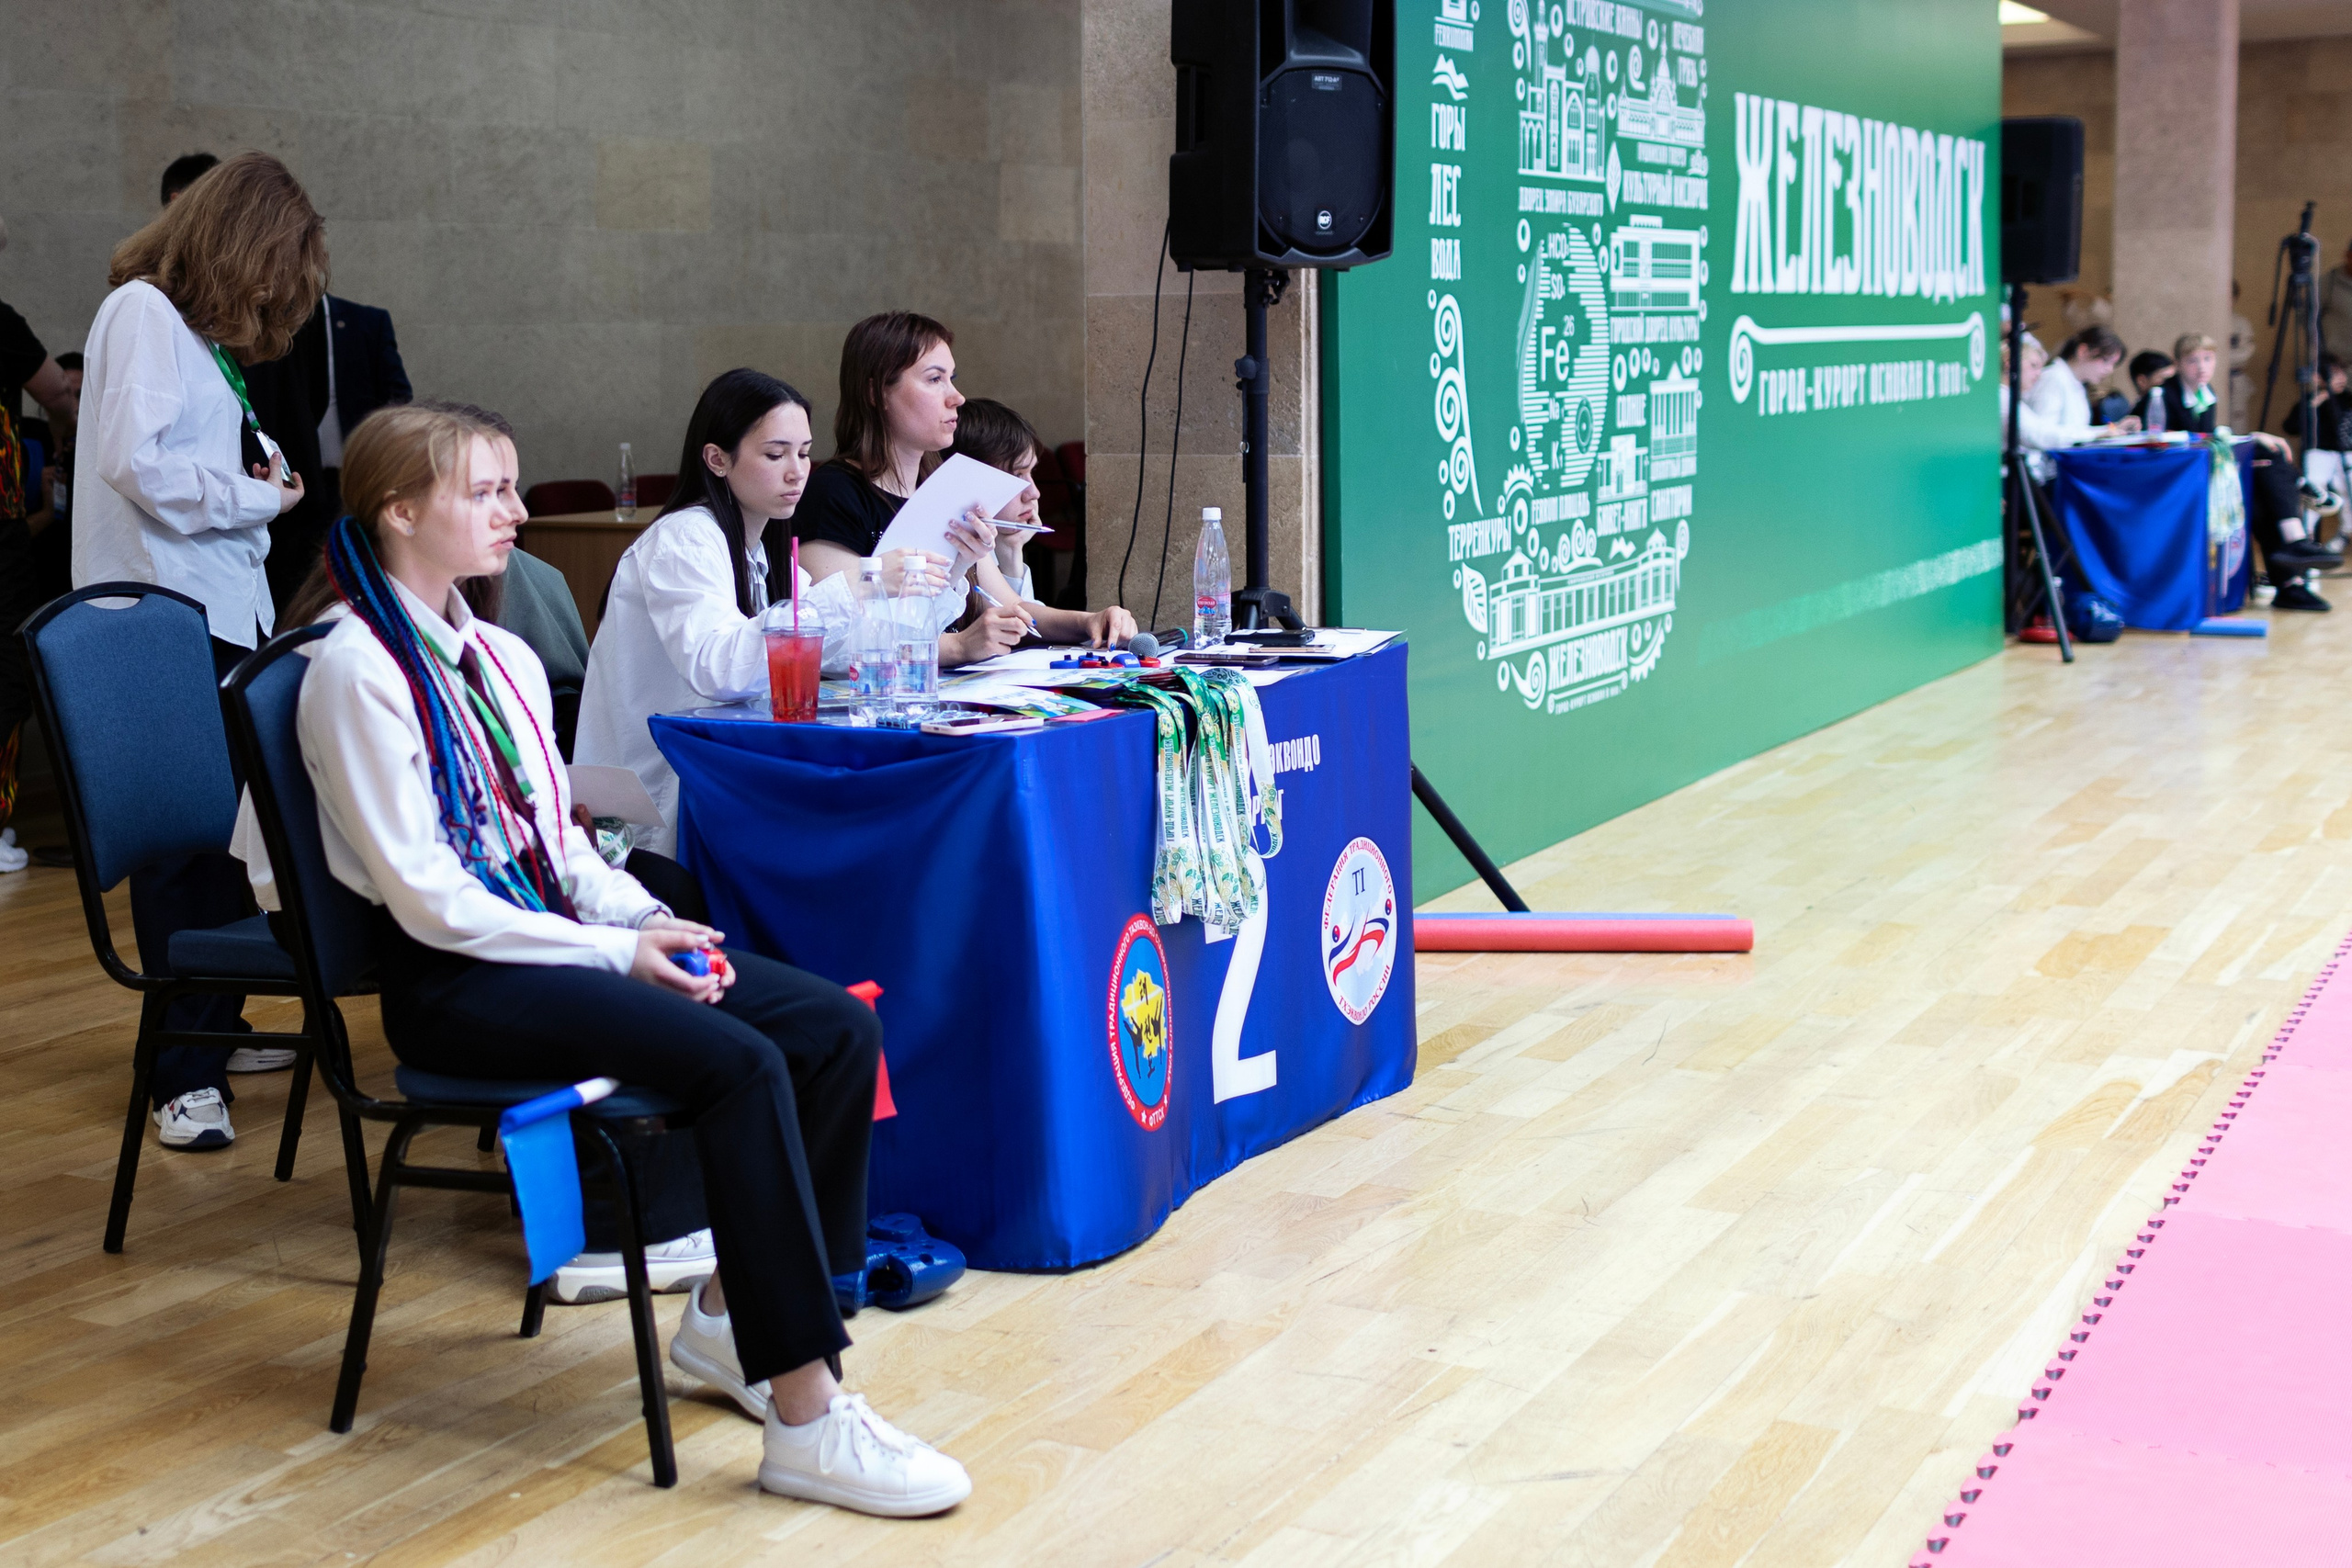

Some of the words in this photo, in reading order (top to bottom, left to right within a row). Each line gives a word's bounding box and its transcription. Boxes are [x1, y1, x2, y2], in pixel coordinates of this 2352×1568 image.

[1431, 103, 1465, 152] ГОРЫ
[1430, 164, 1462, 228] ЛЕС
[1731, 92, 1985, 305] ЖЕЛЕЗНОВОДСК
[1430, 238, 1462, 281] ВОДА
[1541, 326, 1570, 381] Fe
[1758, 364, 1866, 416] ГОРОД-КУРОРТ
[1870, 361, 1923, 404] ОСНОВАН
[1927, 359, 1934, 399] В
[1448, 515, 1512, 561] ТЕРРЕНКУРЫ
[1547, 626, 1628, 692] ЖЕЛЕЗНОВОДСК
[1163, 738, 1174, 792] ЖЕЛЕЗНОВОДСК
[1269, 734, 1320, 773] ЭКВОНДО
[1324, 852, 1349, 930] ФЕДЕРАЦИЯ
[1350, 840, 1392, 894] ТРАДИЦИОННОГО
[1108, 932, 1130, 1039] ТРАДИЦИОННОГО
[1204, 846, 1277, 1104] 2
[1368, 964, 1390, 1010] РОССИИ
[1110, 1042, 1136, 1111] ФЕДЕРАЦИЯ
[1148, 1106, 1165, 1127] ФТТСК
